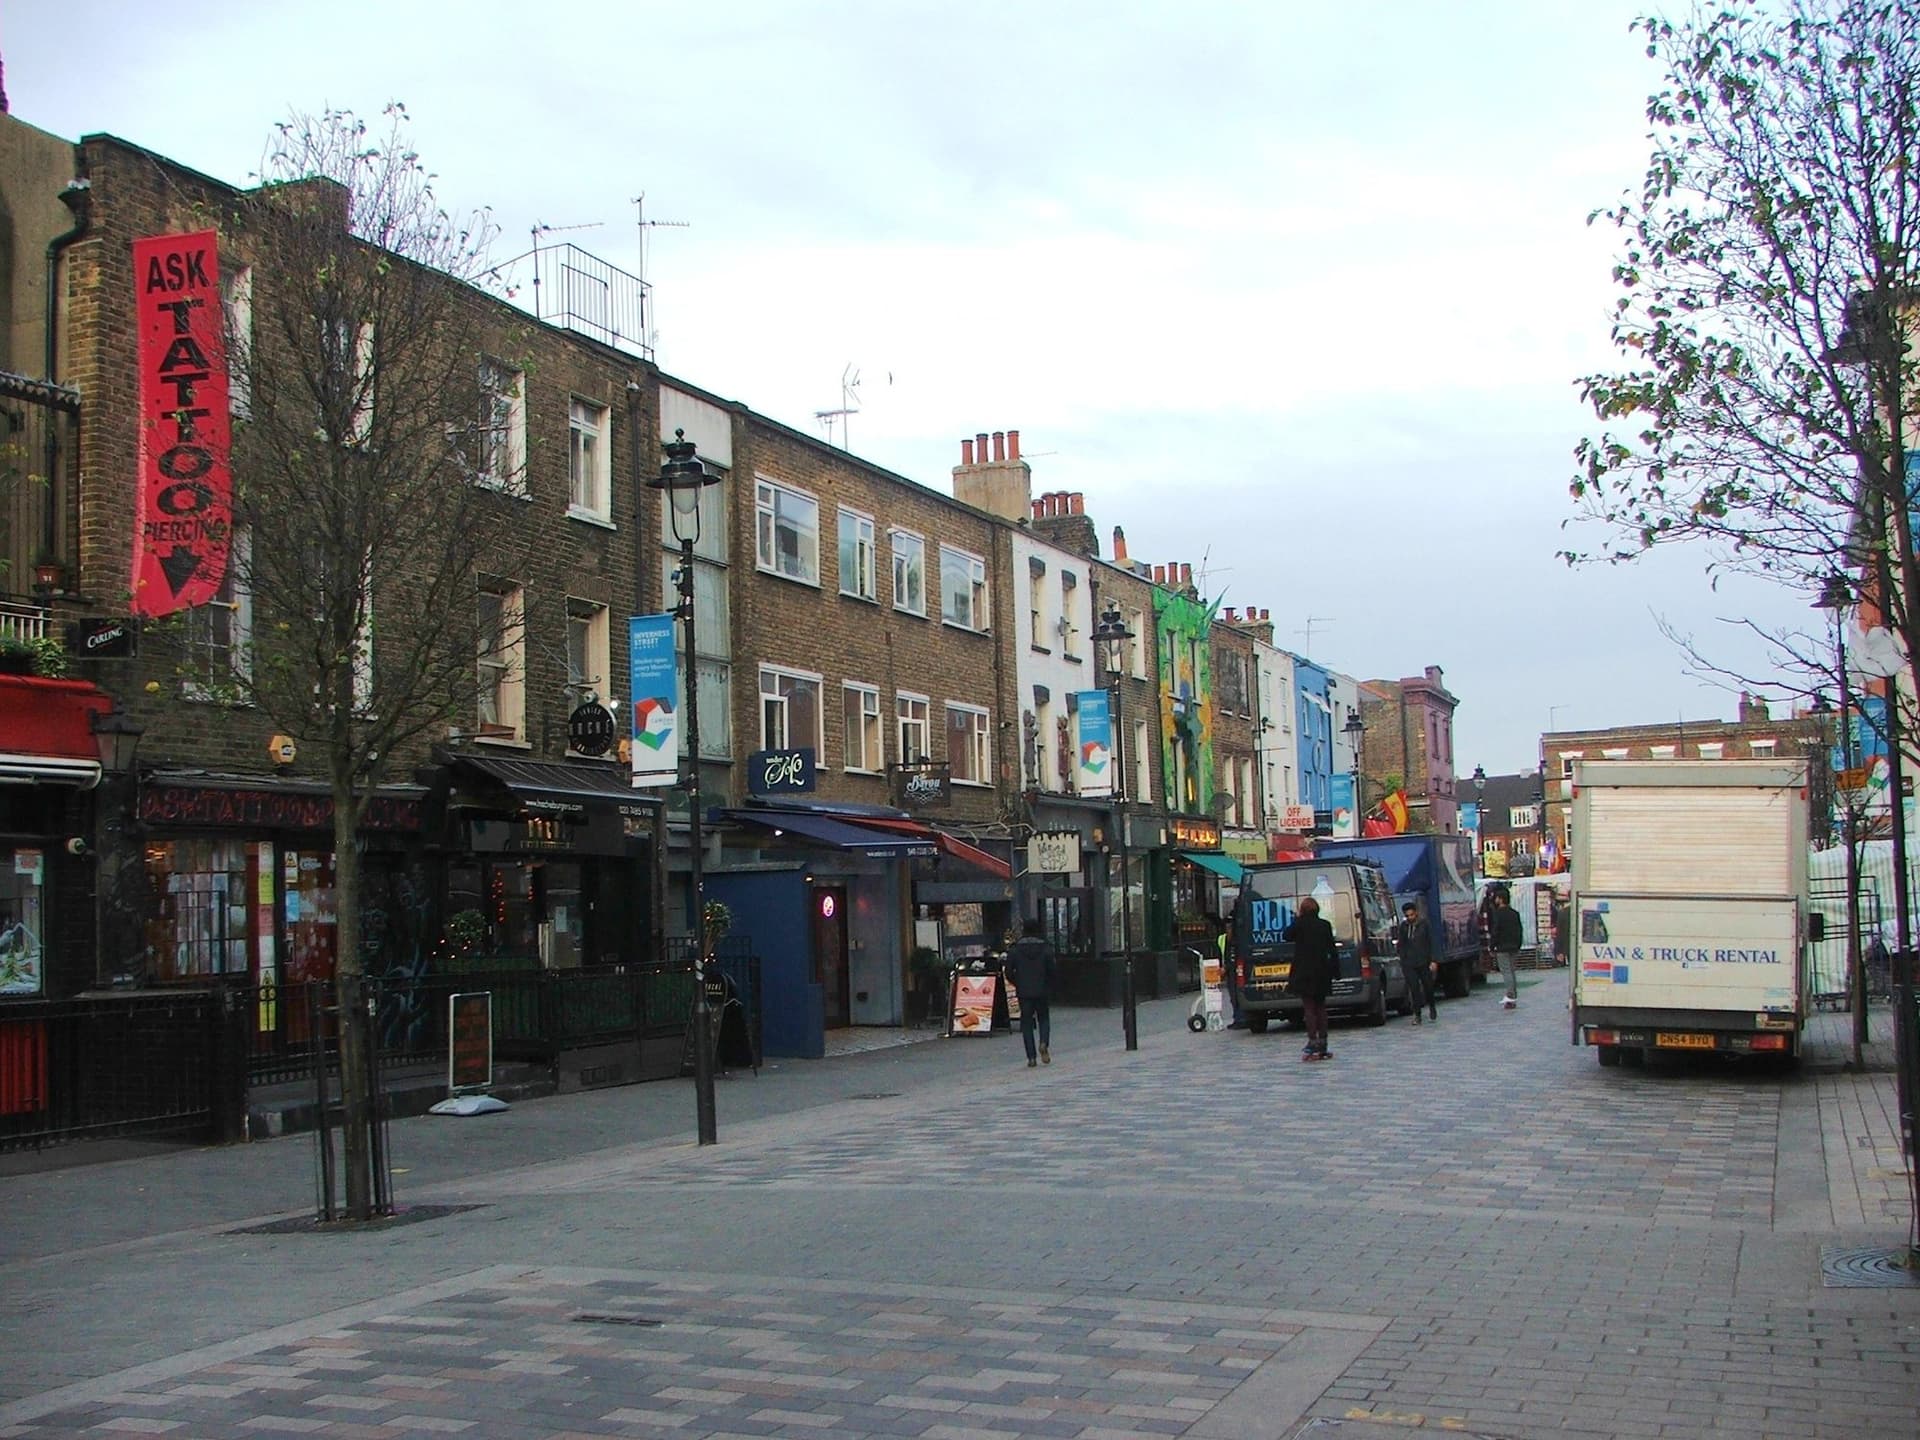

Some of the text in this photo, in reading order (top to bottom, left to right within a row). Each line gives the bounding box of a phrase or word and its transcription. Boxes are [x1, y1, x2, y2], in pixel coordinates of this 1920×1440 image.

[147, 250, 209, 294] ASK
[157, 298, 213, 516] TATTOO
[144, 518, 227, 543] PIERCING
[87, 626, 123, 649] CARLING
[1279, 816, 1312, 827] LICENCE
[1287, 807, 1301, 817] OFF
[1592, 946, 1781, 964] VAN & TRUCK RENTAL
